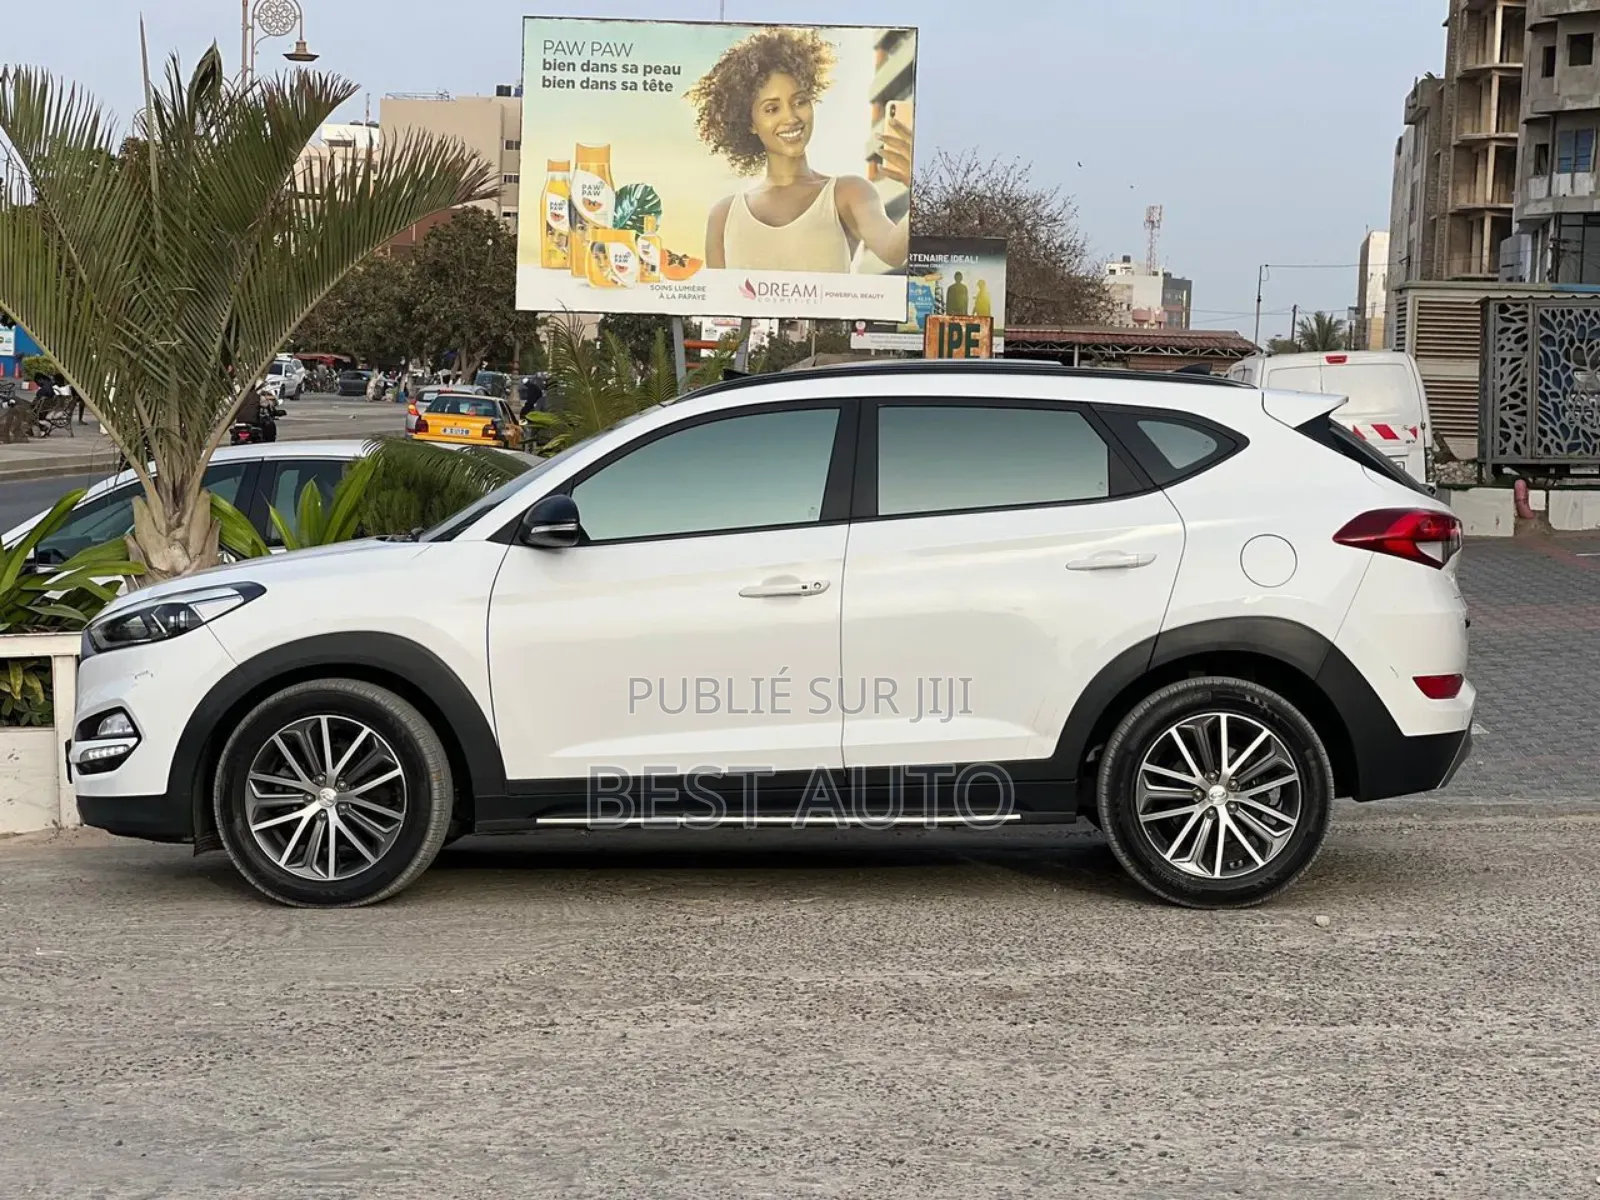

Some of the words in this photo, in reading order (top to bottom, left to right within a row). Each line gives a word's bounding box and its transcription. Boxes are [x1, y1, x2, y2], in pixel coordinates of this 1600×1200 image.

[543, 39, 586, 56] PAW
[590, 41, 634, 57] PAW
[542, 58, 576, 72] bien
[580, 59, 618, 73] dans
[621, 63, 639, 74] sa
[642, 63, 682, 77] peau
[541, 75, 576, 89] bien
[579, 76, 617, 91] dans
[620, 80, 638, 91] sa
[642, 78, 674, 92] tête
[678, 293, 707, 301] PAPAYE
[758, 281, 818, 297] DREAM
[825, 291, 859, 299] POWERFUL
